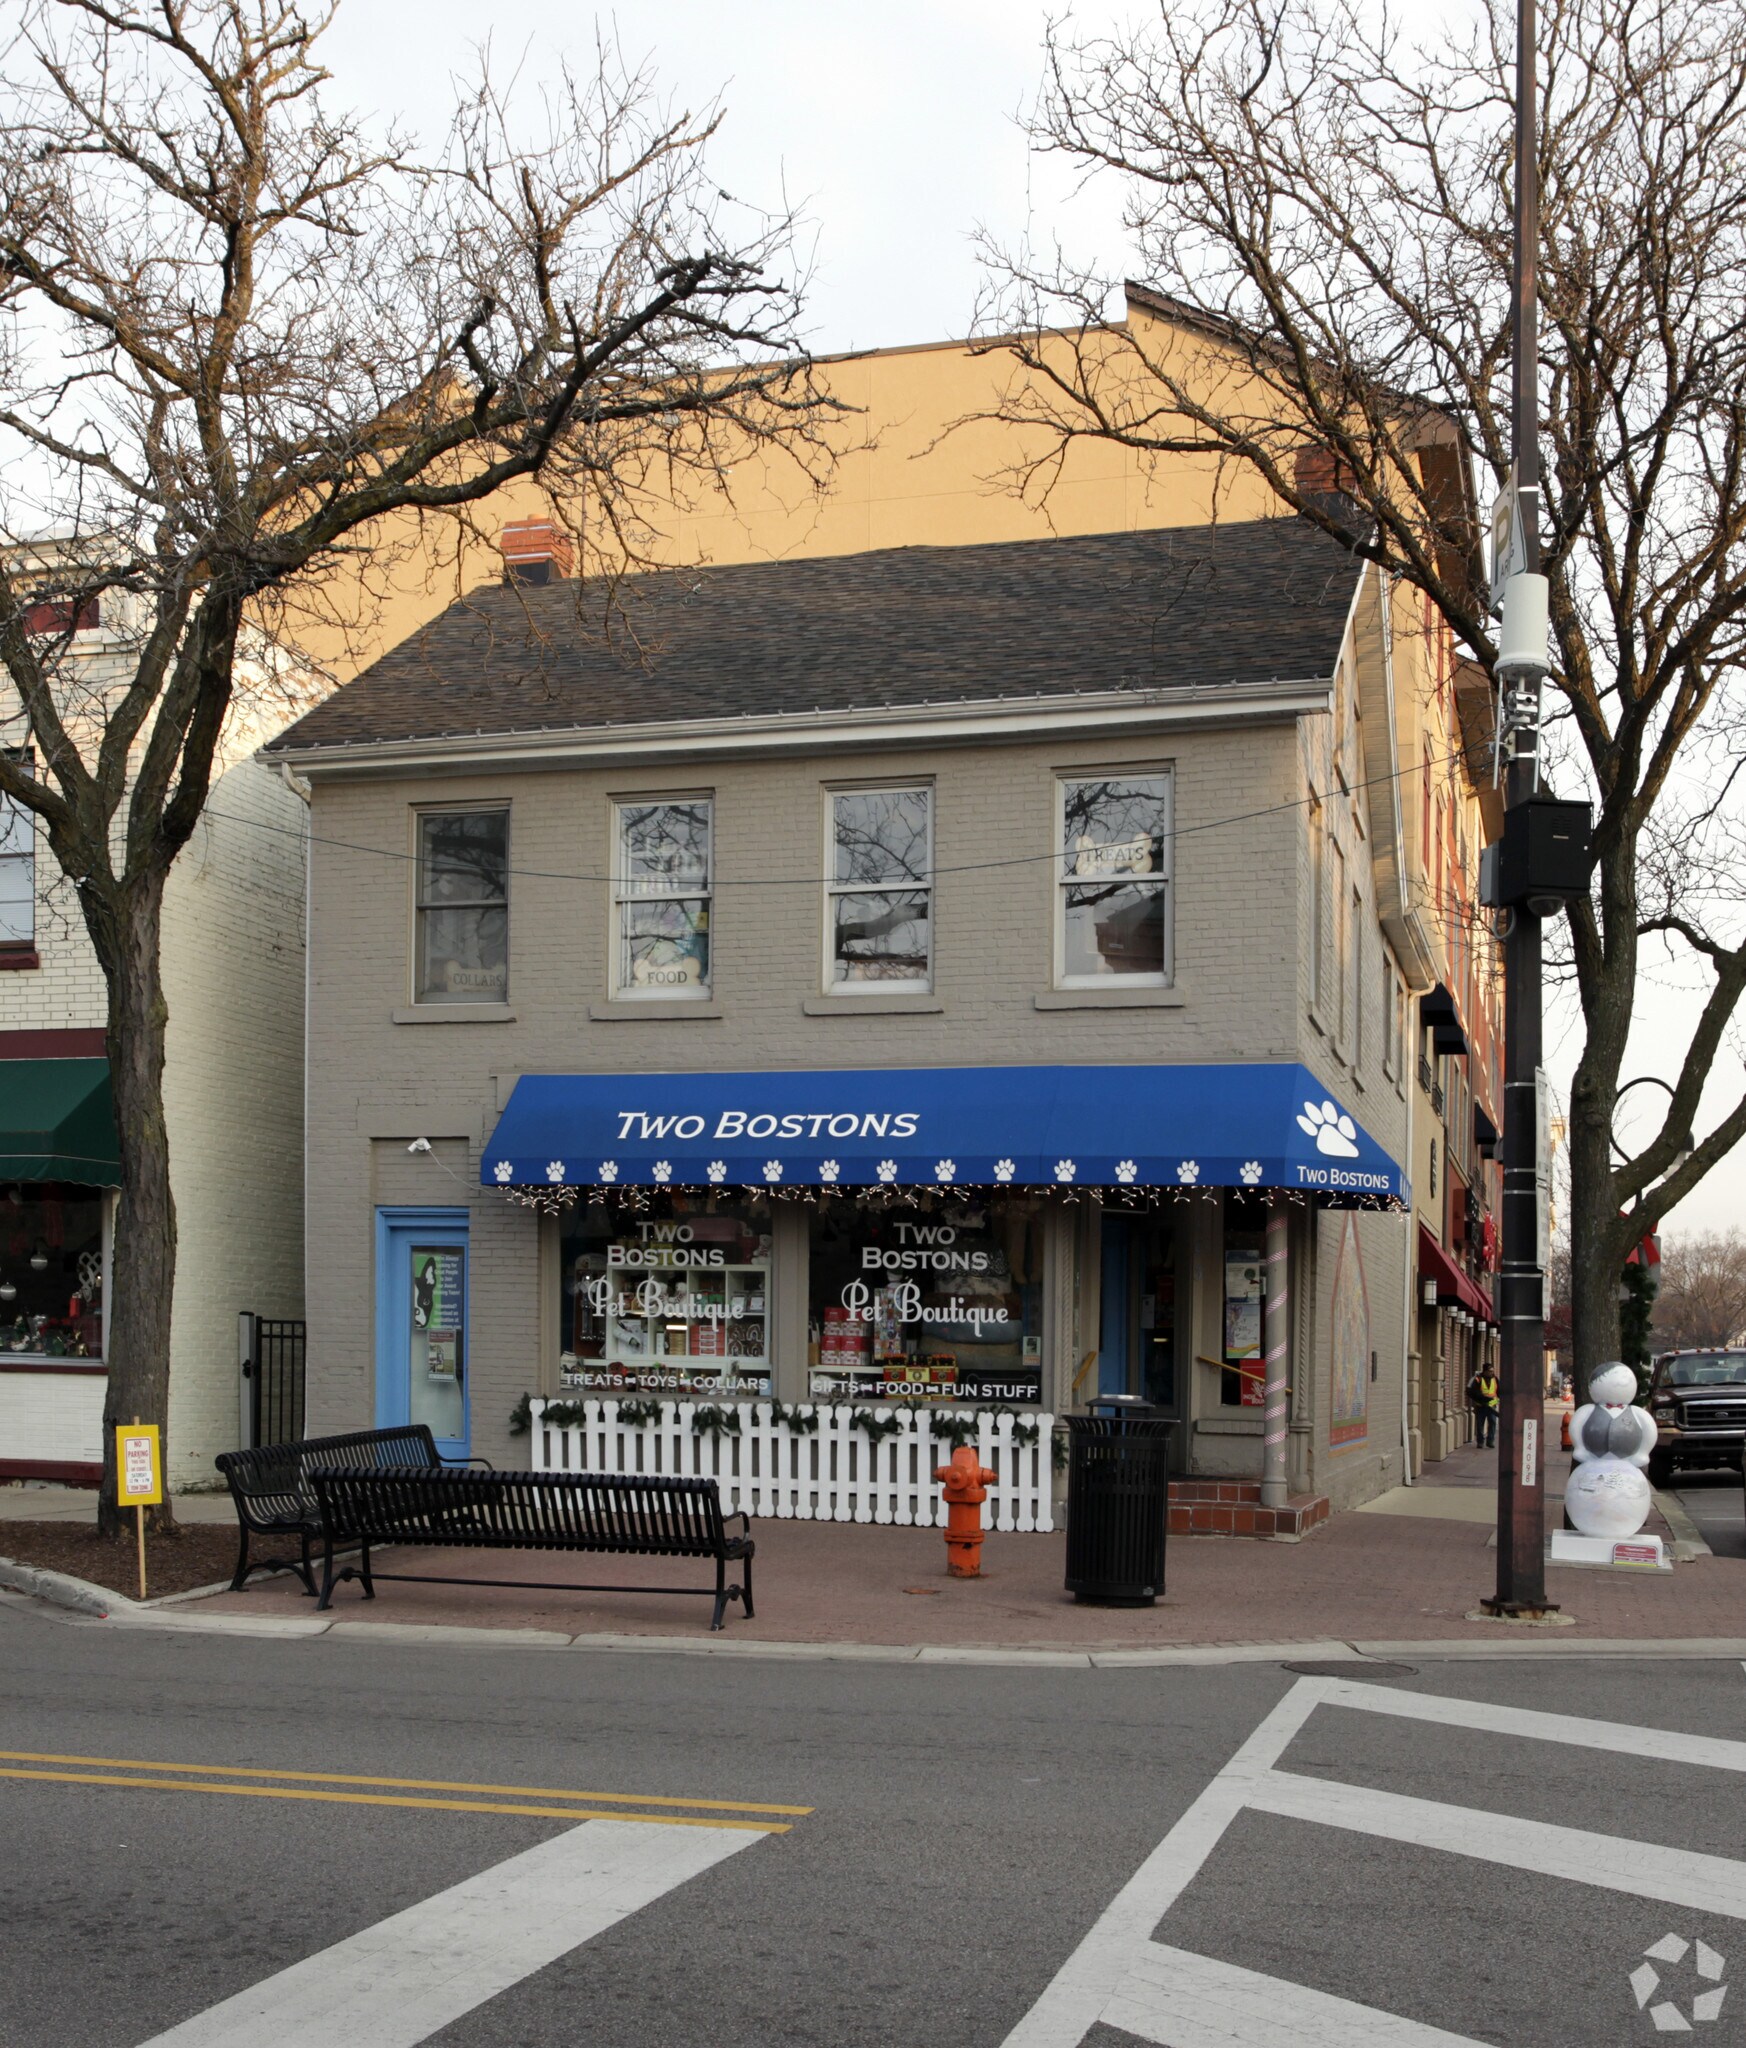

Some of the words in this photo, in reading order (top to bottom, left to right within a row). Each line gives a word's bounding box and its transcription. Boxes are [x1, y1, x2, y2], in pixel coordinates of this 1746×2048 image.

[1085, 846, 1144, 863] TREATS
[453, 973, 503, 987] COLLARS
[647, 971, 687, 985] FOOD
[617, 1111, 705, 1139] TWO
[713, 1111, 921, 1139] BOSTONS
[636, 1221, 694, 1243] TWO
[893, 1222, 956, 1245] TWO
[607, 1245, 725, 1267] BOSTONS
[862, 1247, 988, 1270] BOSTONS
[587, 1274, 626, 1318] Pet
[636, 1274, 744, 1332] Boutique
[841, 1277, 882, 1323] Pet
[893, 1278, 1009, 1337] Boutique
[564, 1373, 623, 1386] TREATS
[638, 1375, 677, 1387] TOYS
[693, 1376, 769, 1389] COLLARS
[810, 1380, 859, 1393] GIFTS
[876, 1382, 925, 1395] FOOD
[942, 1383, 978, 1397] FUN
[982, 1384, 1038, 1398] STUFF
[128, 1450, 149, 1458] PARKING
